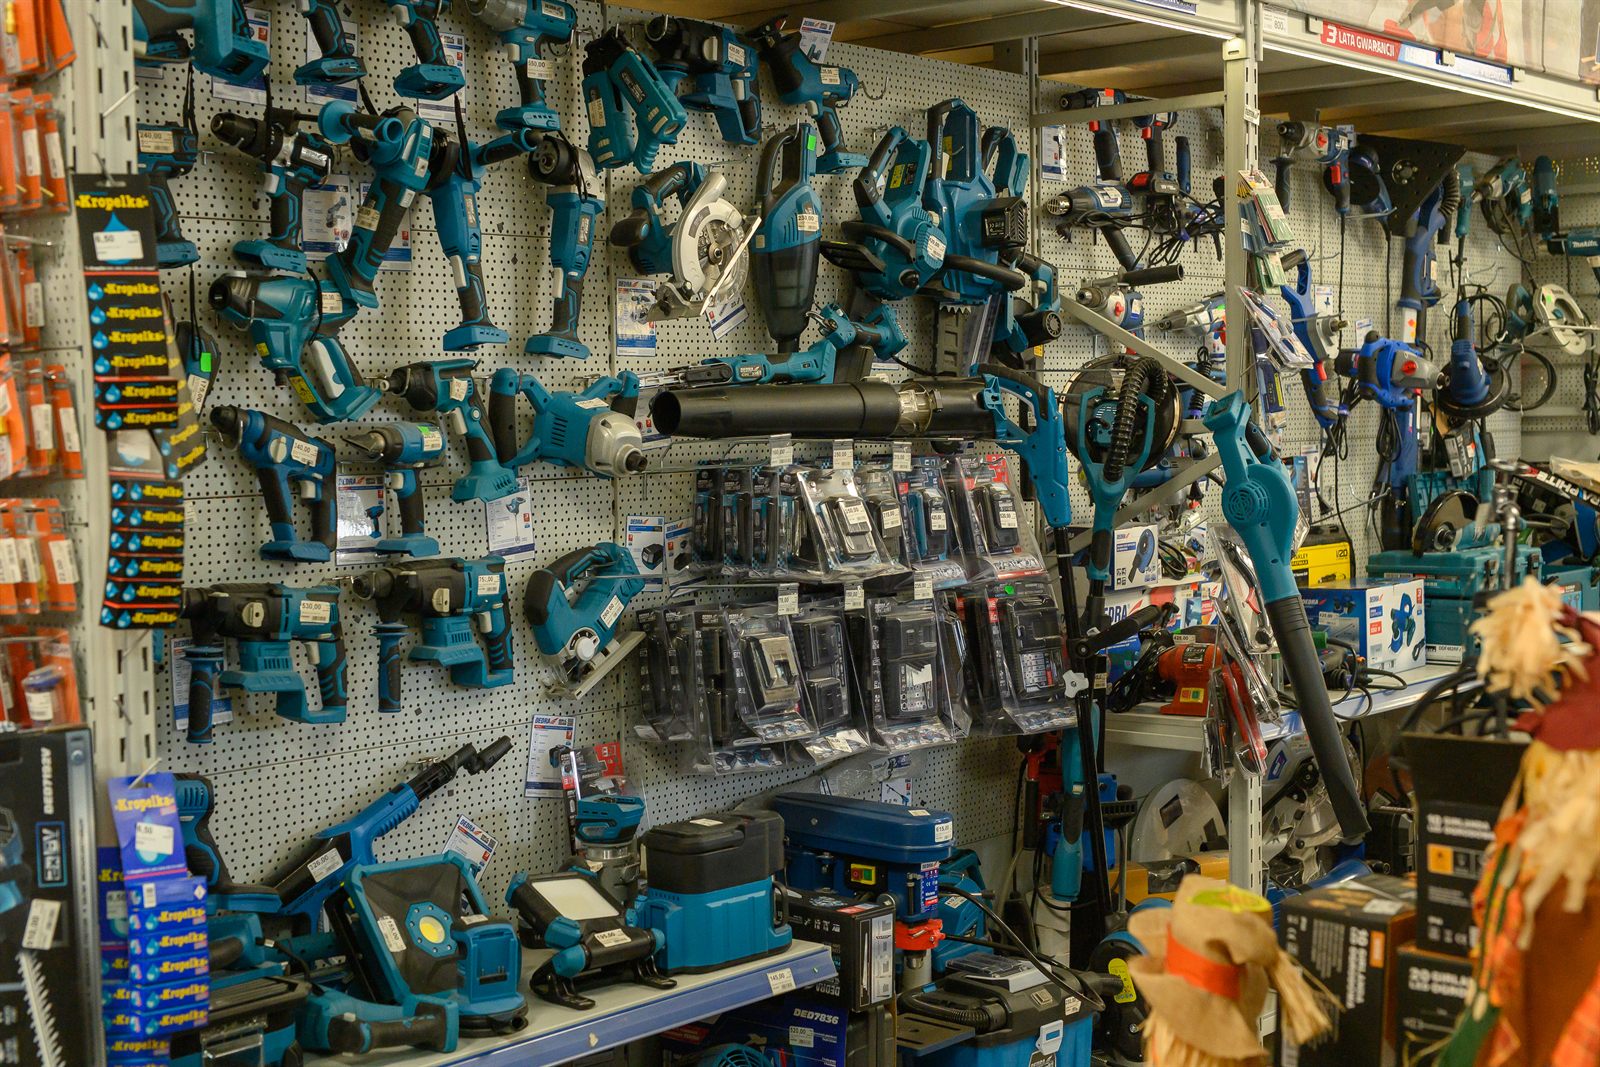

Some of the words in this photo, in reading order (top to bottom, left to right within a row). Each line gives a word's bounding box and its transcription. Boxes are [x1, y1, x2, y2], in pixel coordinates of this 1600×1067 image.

[1326, 24, 1337, 43] 3
[1338, 31, 1355, 47] LATA
[1356, 35, 1395, 57] GWARANCJI
[77, 194, 147, 211] Kropelka
[104, 283, 159, 297] Kropelka
[108, 306, 162, 320] Kropelka
[109, 331, 165, 345] Kropelka
[111, 355, 167, 369] Kropelka
[122, 385, 177, 399] Kropelka
[123, 410, 178, 425] Kropelka
[143, 485, 183, 498] Kropelka
[1537, 471, 1600, 508] RAPHITE
[142, 511, 183, 525] Kropelka
[141, 536, 183, 550] Kropelka
[140, 561, 182, 575] Kropelka
[137, 586, 181, 600] Kropelka
[132, 612, 177, 627] Kropelka
[1104, 604, 1128, 624] EDRA
[116, 794, 174, 813] Kropelka
[158, 908, 206, 924] Kropelka
[159, 933, 207, 949] Kropelka
[160, 958, 208, 974] Kropelka
[160, 984, 208, 1000] Kropelka
[160, 1010, 208, 1027] Kropelka
[794, 1008, 839, 1025] DED7836
